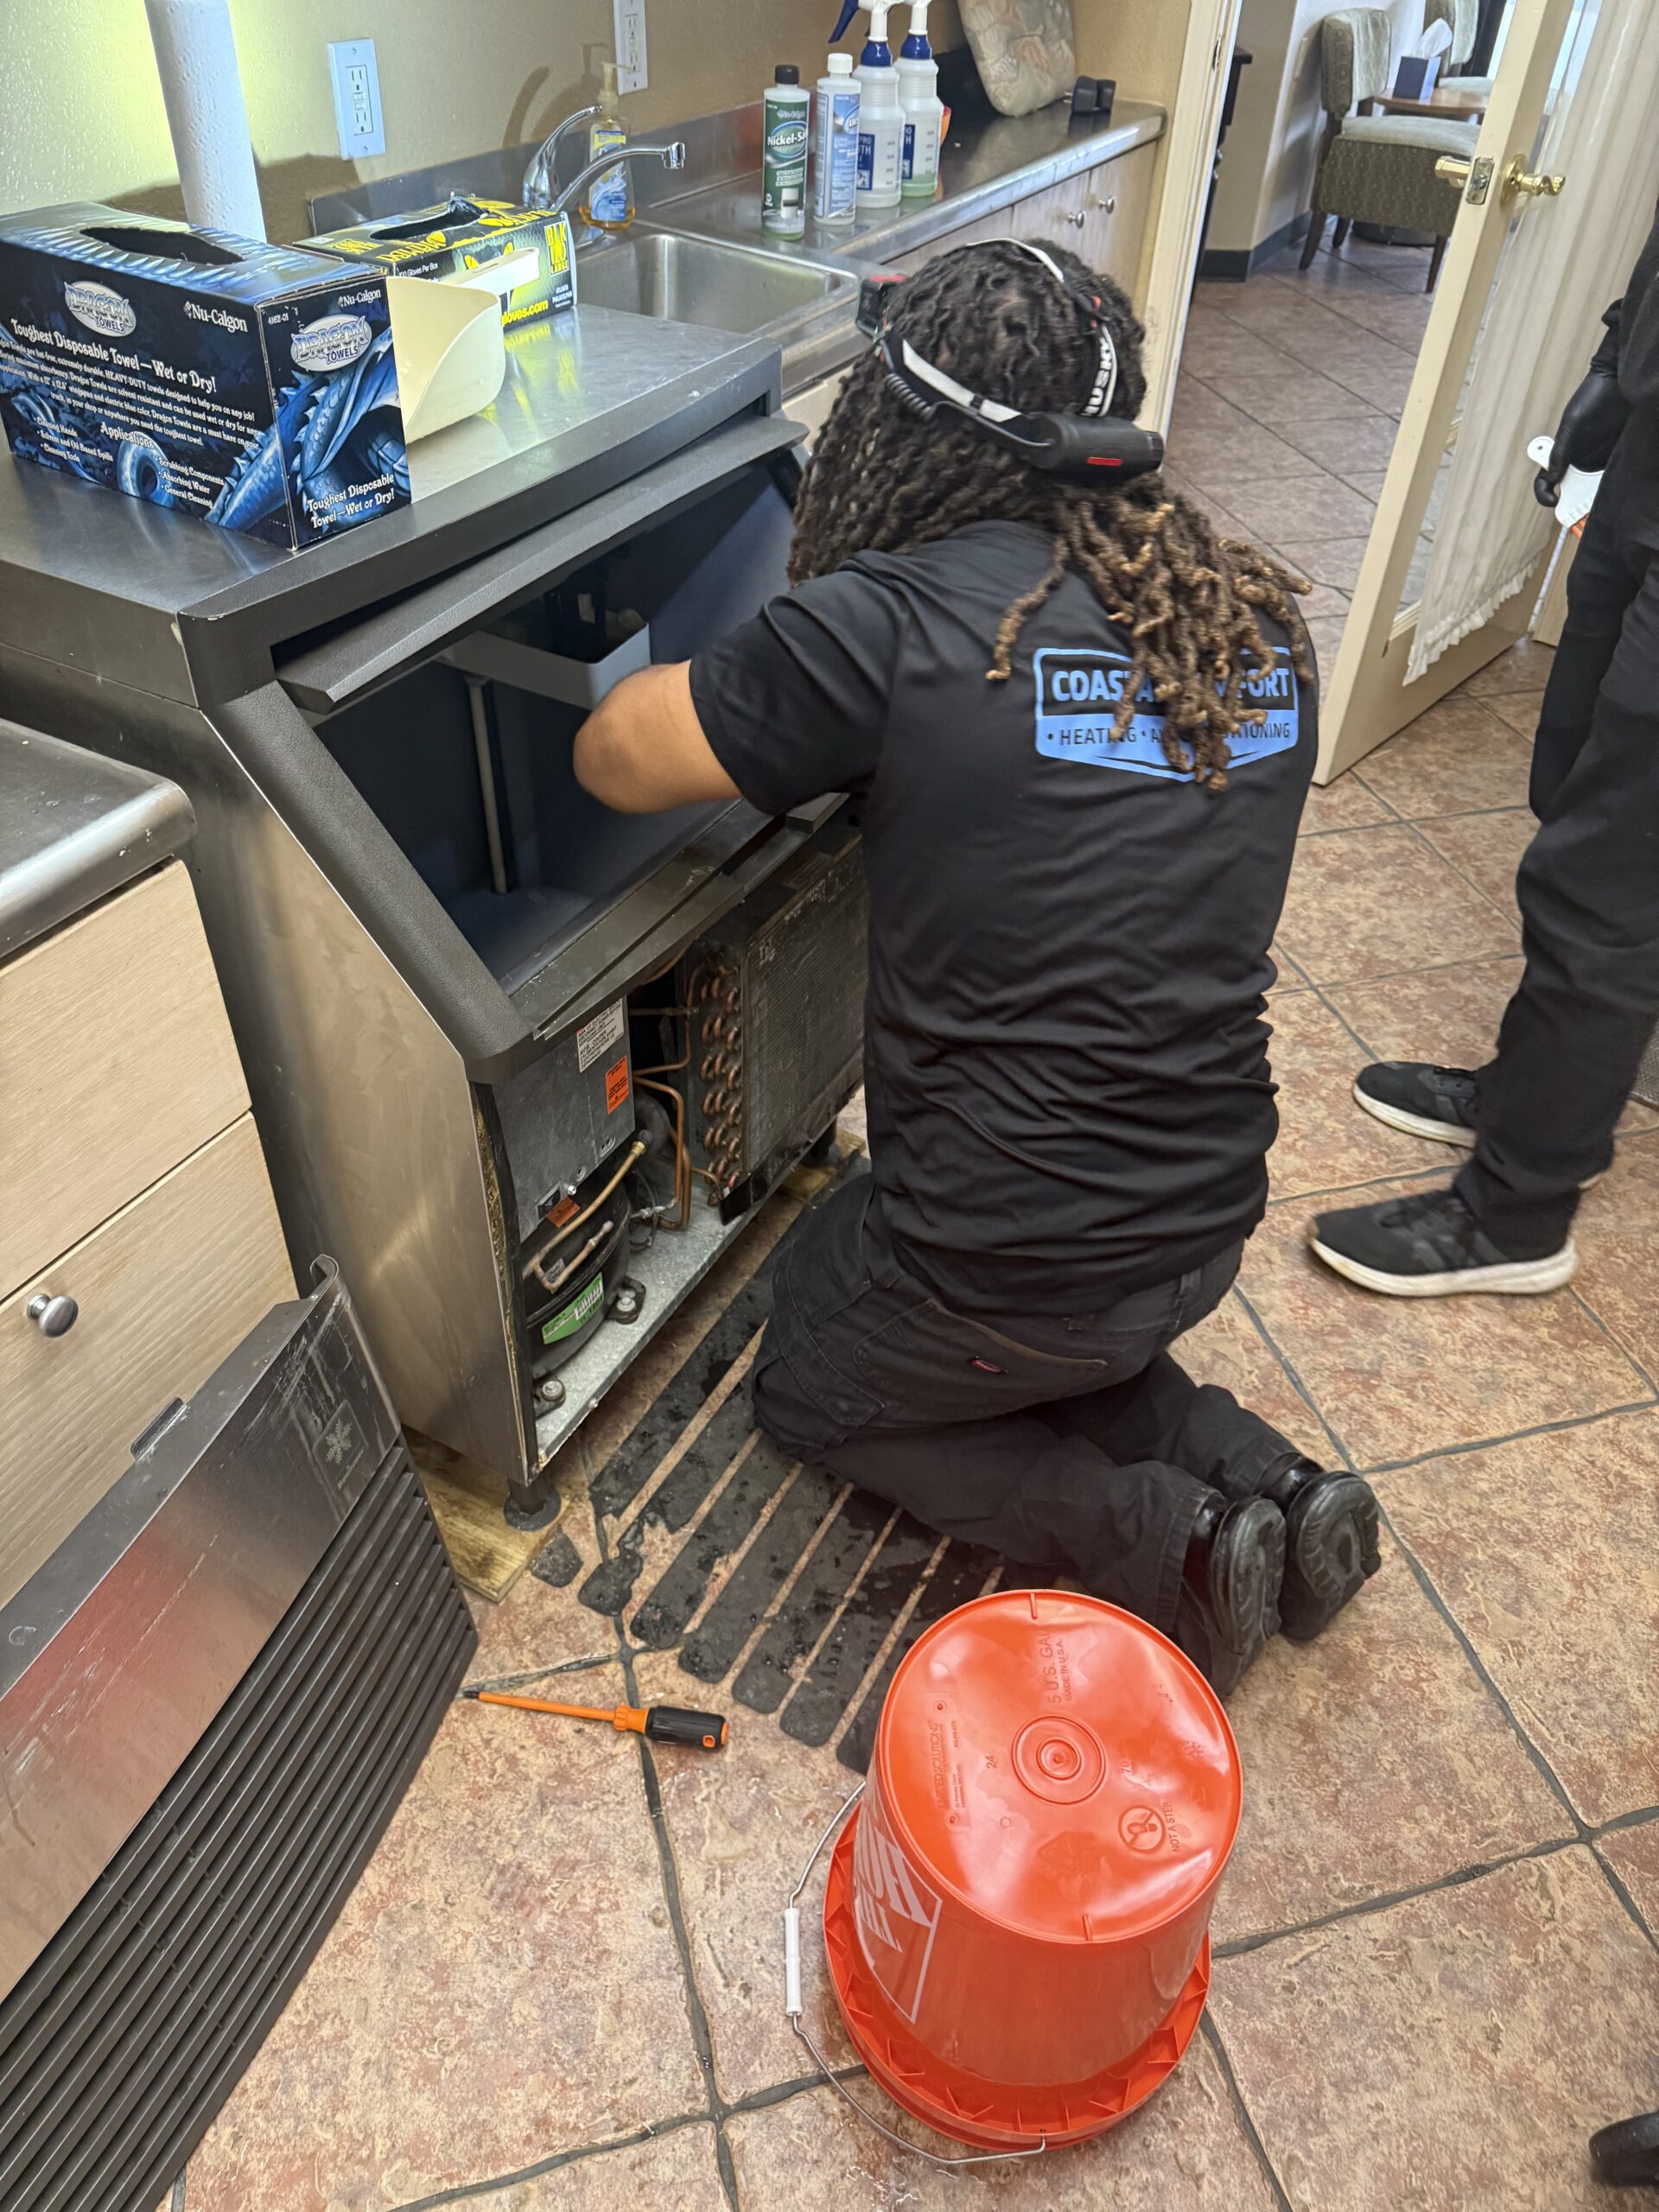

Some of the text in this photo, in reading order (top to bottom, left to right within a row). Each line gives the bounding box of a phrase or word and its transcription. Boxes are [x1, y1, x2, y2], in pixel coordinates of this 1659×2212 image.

[408, 266, 422, 277] Gloves
[64, 282, 133, 327] DRAGON
[342, 289, 382, 308] Nu-Calgon
[95, 316, 124, 333] TOWELS
[192, 303, 249, 334] Nu-Calgon
[291, 315, 368, 364] DRAGON
[327, 346, 359, 363] TOWELS
[10, 318, 54, 345] Toughest
[54, 332, 109, 361] Disposable
[176, 372, 188, 385] or
[189, 370, 216, 394] Dry!
[69, 372, 90, 386] Dragon
[107, 384, 118, 394] are
[118, 387, 137, 400] solvent
[137, 394, 161, 408] resistant
[161, 401, 173, 410] and
[173, 404, 184, 414] can
[185, 406, 192, 416] be
[193, 410, 206, 421] used
[225, 418, 237, 430] dry
[237, 422, 245, 432] for
[245, 427, 257, 437] any
[105, 370, 146, 390] HEAVY-DUTY
[147, 383, 164, 396] towels
[165, 388, 190, 404] designed
[192, 396, 197, 404] to
[197, 397, 211, 410] help
[211, 403, 222, 412] you
[231, 408, 242, 418] any
[243, 410, 256, 422] job!
[72, 399, 84, 409] your
[85, 402, 97, 413] shop
[104, 409, 130, 423] anywhere
[130, 417, 140, 427] you
[140, 420, 154, 431] need
[154, 423, 162, 434] the
[163, 427, 187, 442] toughest
[188, 435, 204, 446] towel.
[93, 391, 104, 402] and
[105, 396, 124, 409] electric
[124, 401, 137, 411] blue
[152, 408, 173, 423] Dragon
[173, 418, 192, 430] Towels
[192, 423, 202, 432] are
[207, 429, 223, 439] must
[223, 431, 237, 442] have
[237, 437, 245, 446] on
[100, 422, 154, 449] Applications
[159, 456, 225, 486] Scrubbing Components
[162, 470, 211, 494] Absorbing Water
[164, 485, 213, 510] General Cleaning
[308, 473, 394, 512] Toughest Disposable
[365, 498, 373, 509] or
[374, 487, 395, 505] Dry!
[1052, 670, 1155, 702] COASA
[1056, 1638, 1066, 1662] U.S.A.
[1044, 1662, 1059, 1692] U.S.
[1063, 1674, 1073, 1700] MADE
[1048, 1695, 1061, 1704] 5
[985, 1755, 996, 1770] 24
[1163, 1802, 1180, 1853] NOT A STEP
